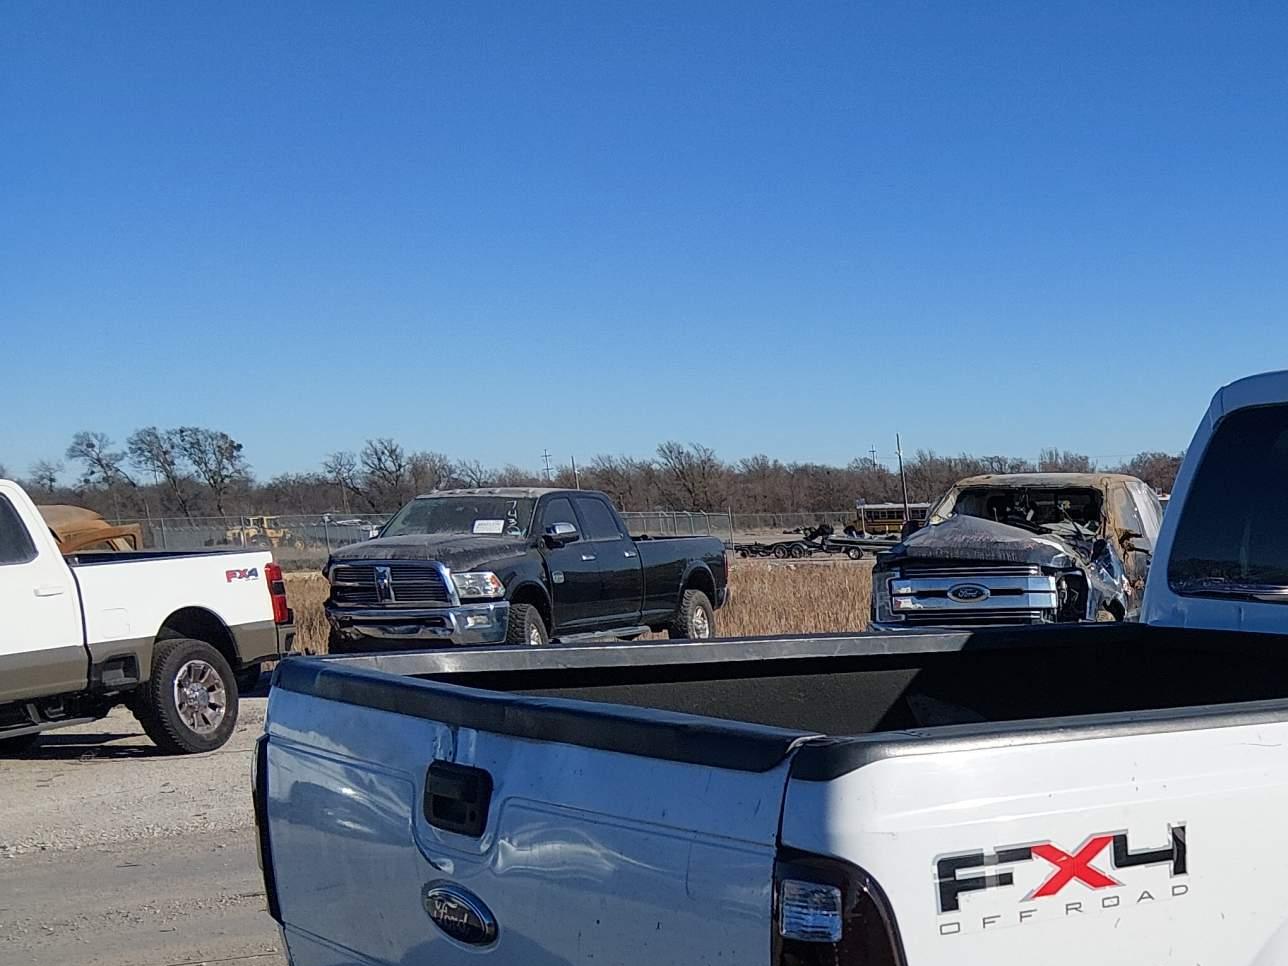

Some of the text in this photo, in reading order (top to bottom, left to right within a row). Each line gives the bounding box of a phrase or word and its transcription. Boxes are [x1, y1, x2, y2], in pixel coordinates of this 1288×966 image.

[225, 568, 259, 583] FX4
[932, 822, 1189, 915] FX4
[938, 884, 1189, 936] OFF ROAD
